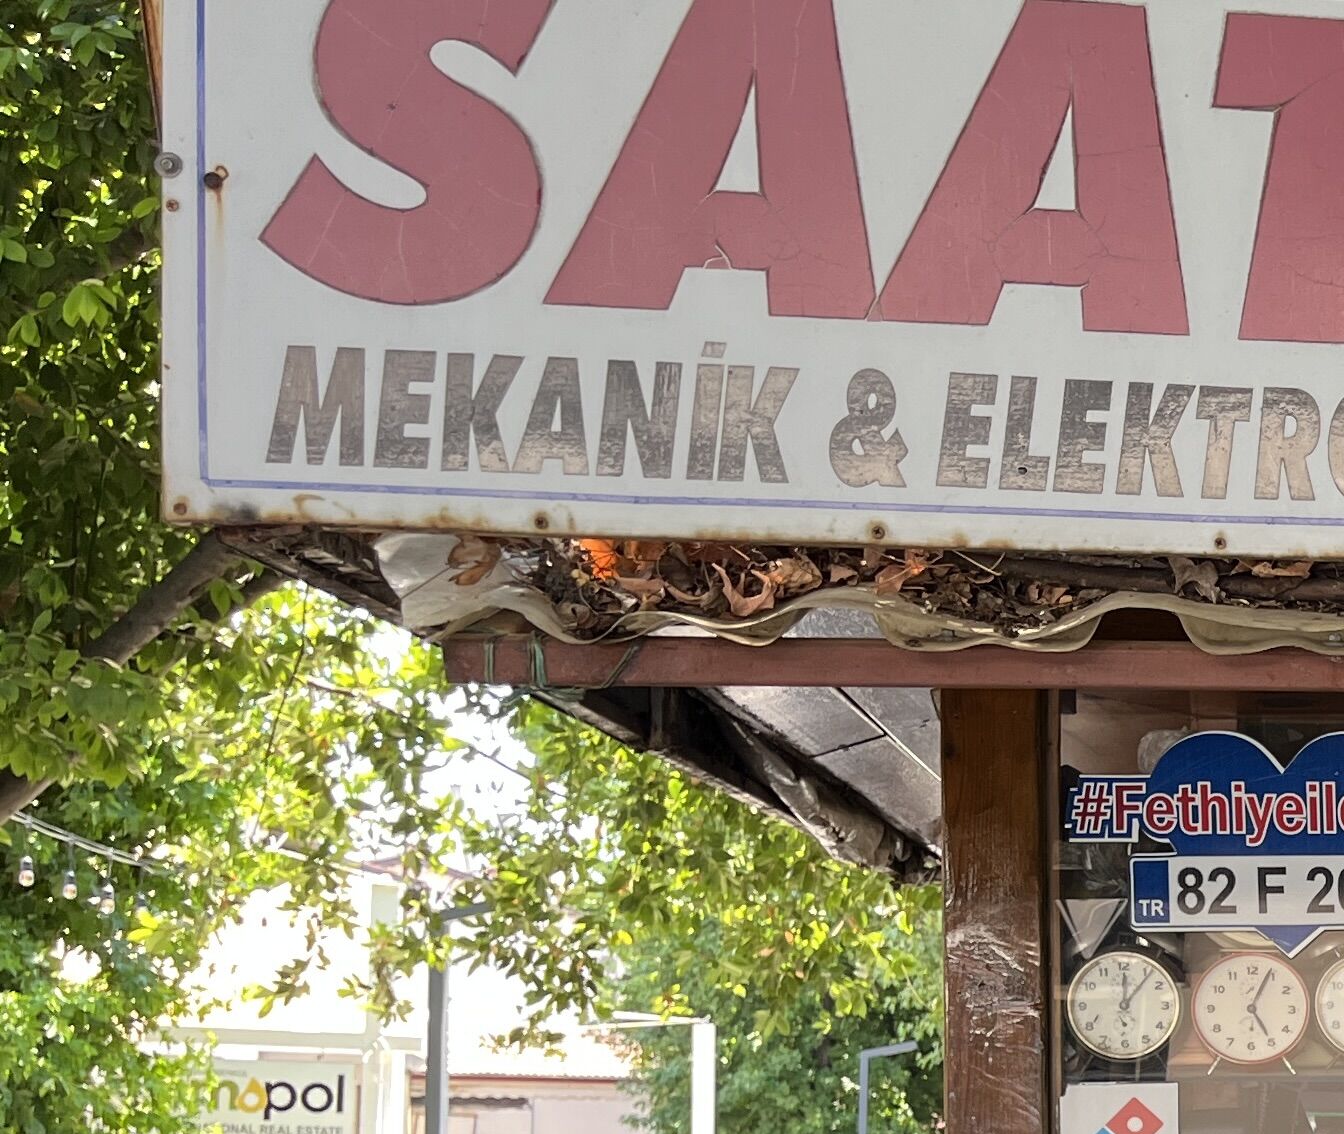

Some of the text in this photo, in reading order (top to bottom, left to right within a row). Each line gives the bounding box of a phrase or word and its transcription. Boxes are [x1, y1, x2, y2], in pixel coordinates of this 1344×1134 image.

[264, 342, 796, 483] MEKANİK
[828, 368, 909, 488] &
[1139, 900, 1164, 917] TR
[1177, 866, 1237, 915] 82
[1258, 867, 1287, 914] F
